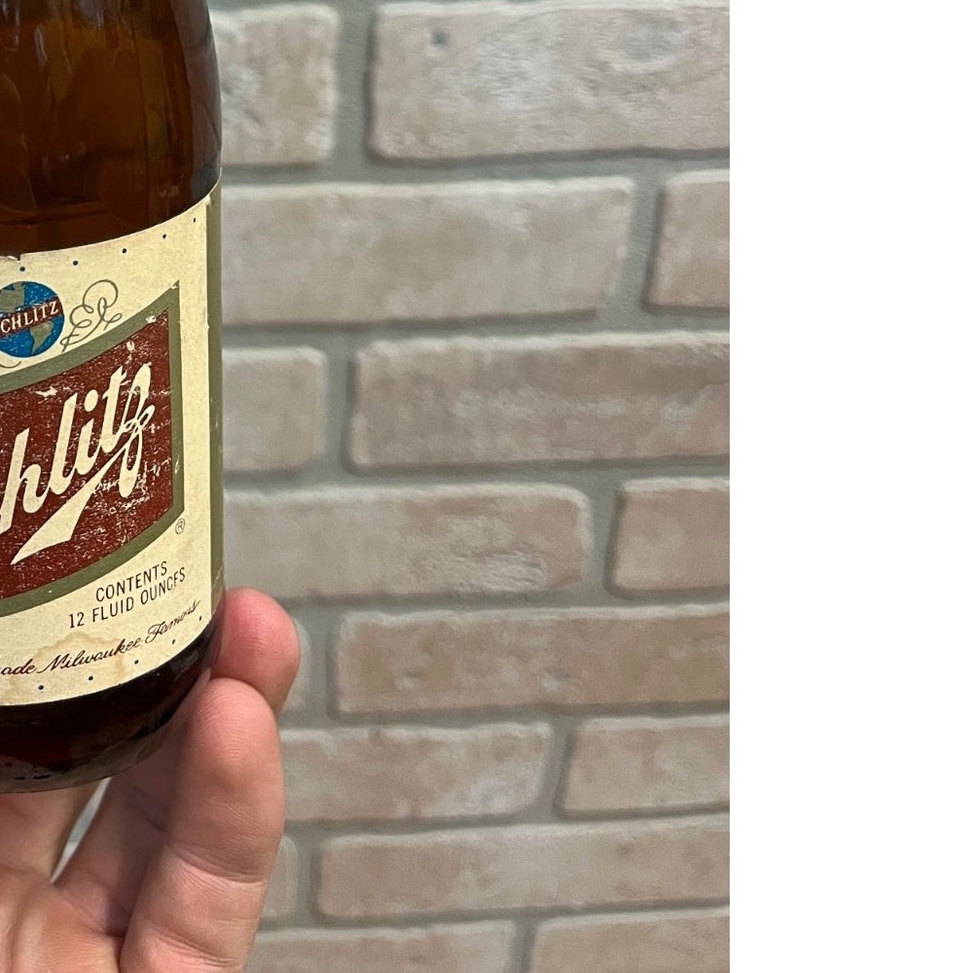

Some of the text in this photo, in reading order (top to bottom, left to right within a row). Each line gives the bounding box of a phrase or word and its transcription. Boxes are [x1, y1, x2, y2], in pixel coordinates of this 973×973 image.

[95, 560, 168, 603] CONTENTS
[69, 611, 85, 629] 12
[91, 596, 135, 623] FLUID
[36, 638, 141, 674] Milwaukee
